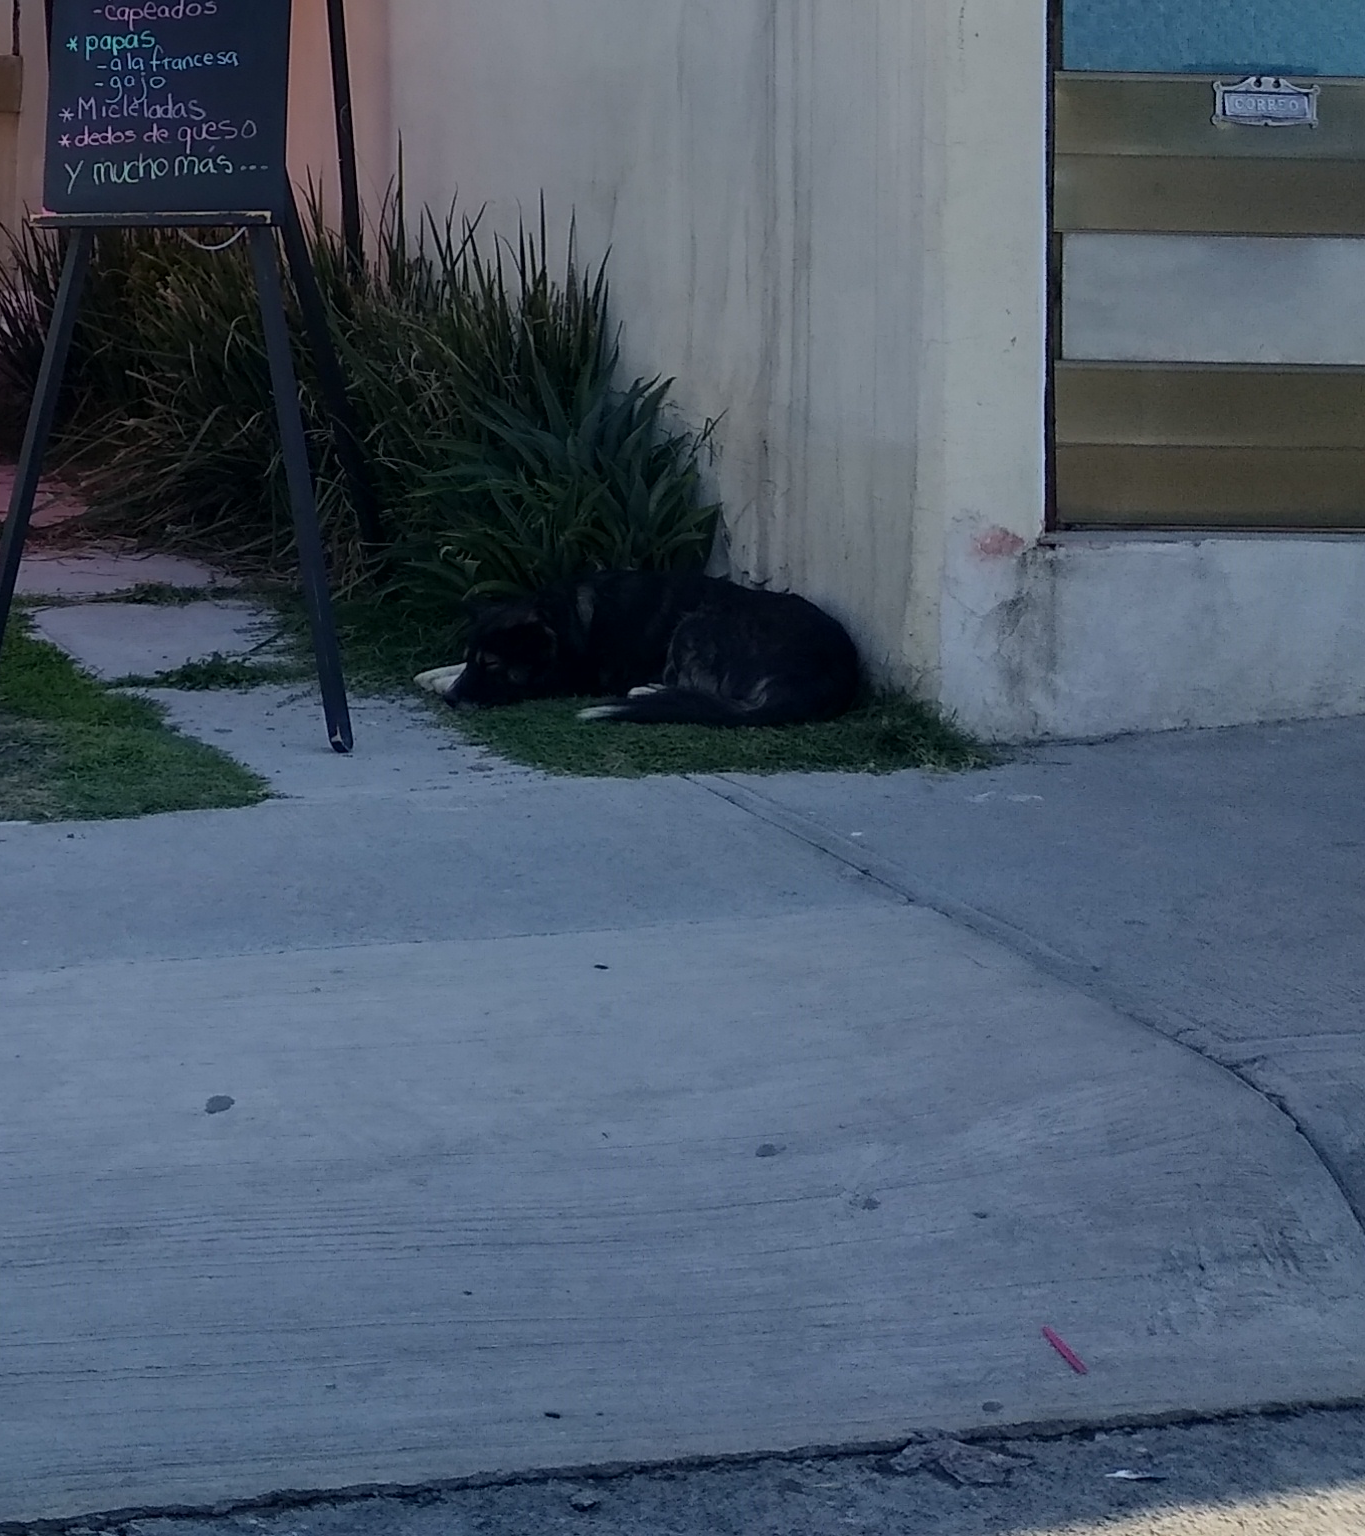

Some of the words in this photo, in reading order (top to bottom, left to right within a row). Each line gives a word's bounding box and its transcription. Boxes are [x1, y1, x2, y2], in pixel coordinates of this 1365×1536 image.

[85, 29, 156, 61] papas
[149, 45, 240, 72] francesa
[1234, 98, 1299, 112] CORREO
[74, 125, 137, 147] dedos
[143, 123, 171, 144] de
[177, 119, 257, 154] queso
[93, 152, 170, 185] mucho
